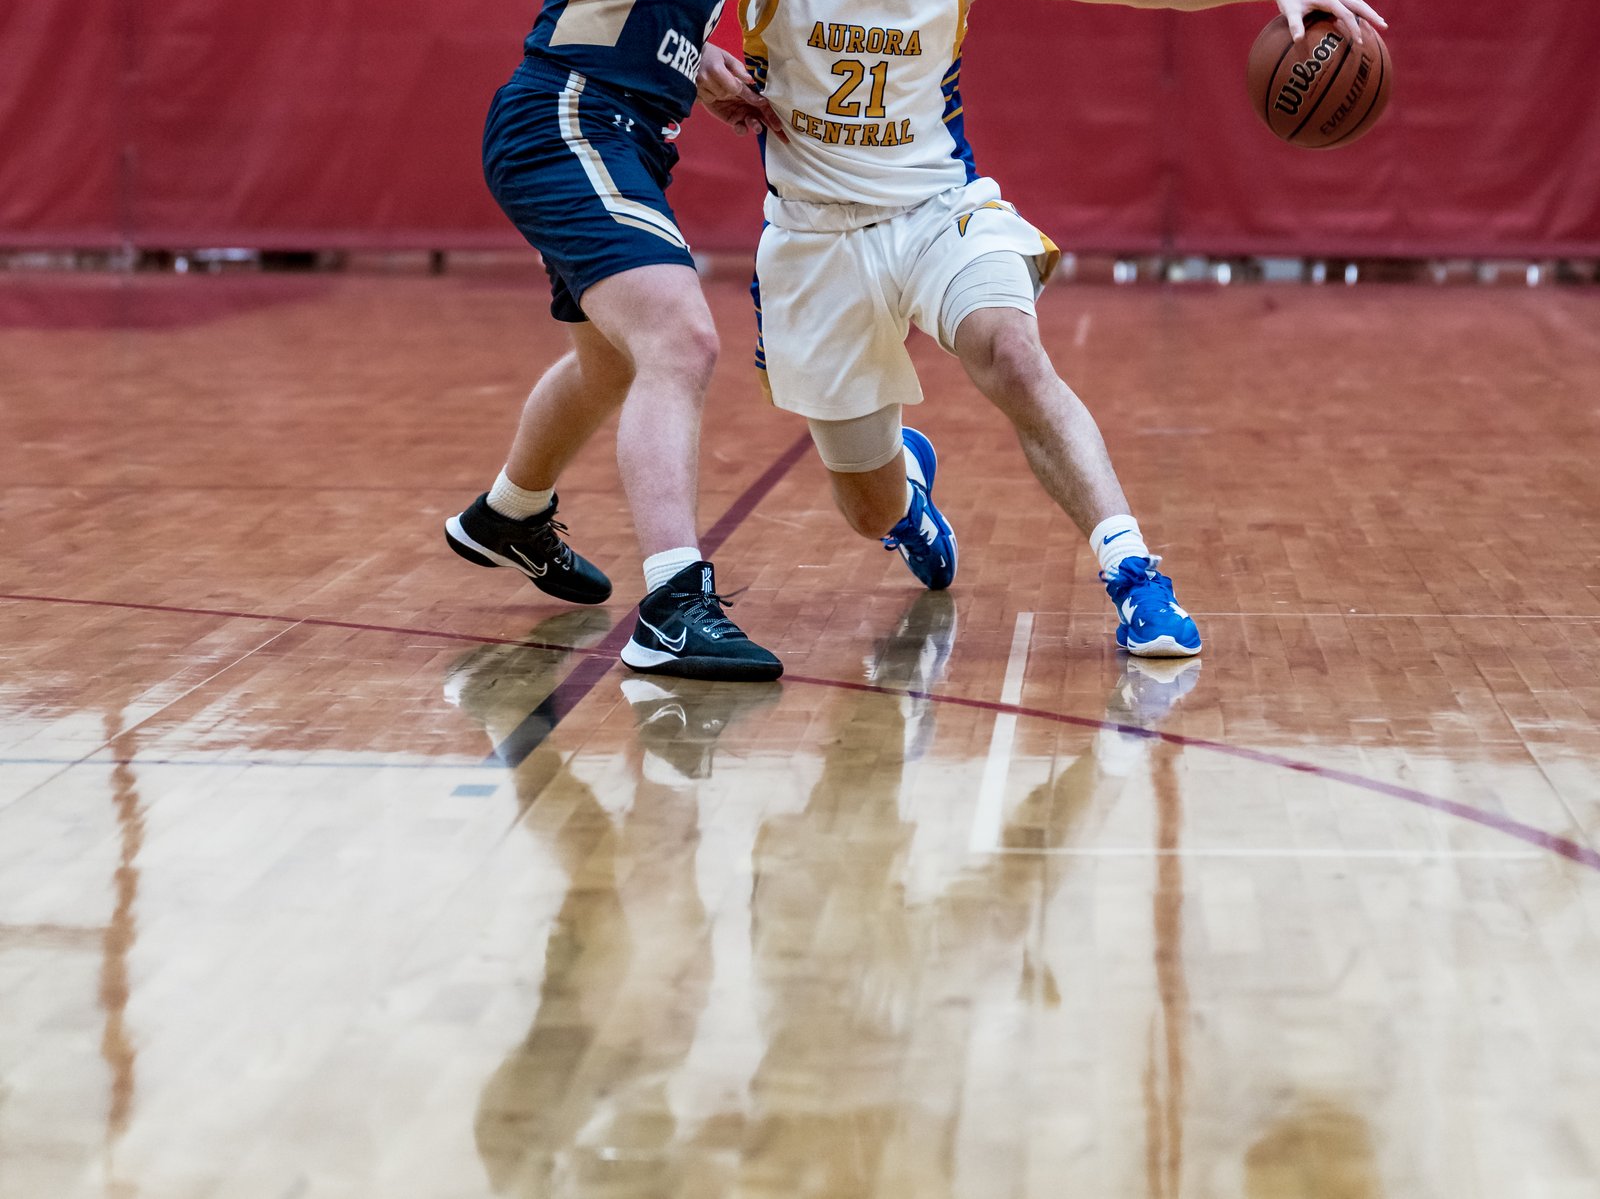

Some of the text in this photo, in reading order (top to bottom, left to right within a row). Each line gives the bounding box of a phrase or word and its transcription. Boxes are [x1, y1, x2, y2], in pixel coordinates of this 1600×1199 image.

[807, 21, 923, 56] AURORA
[825, 59, 889, 119] 21
[1273, 31, 1344, 116] Wilson
[1319, 53, 1373, 136] EVOLUTION
[791, 109, 915, 147] CENTRAL
